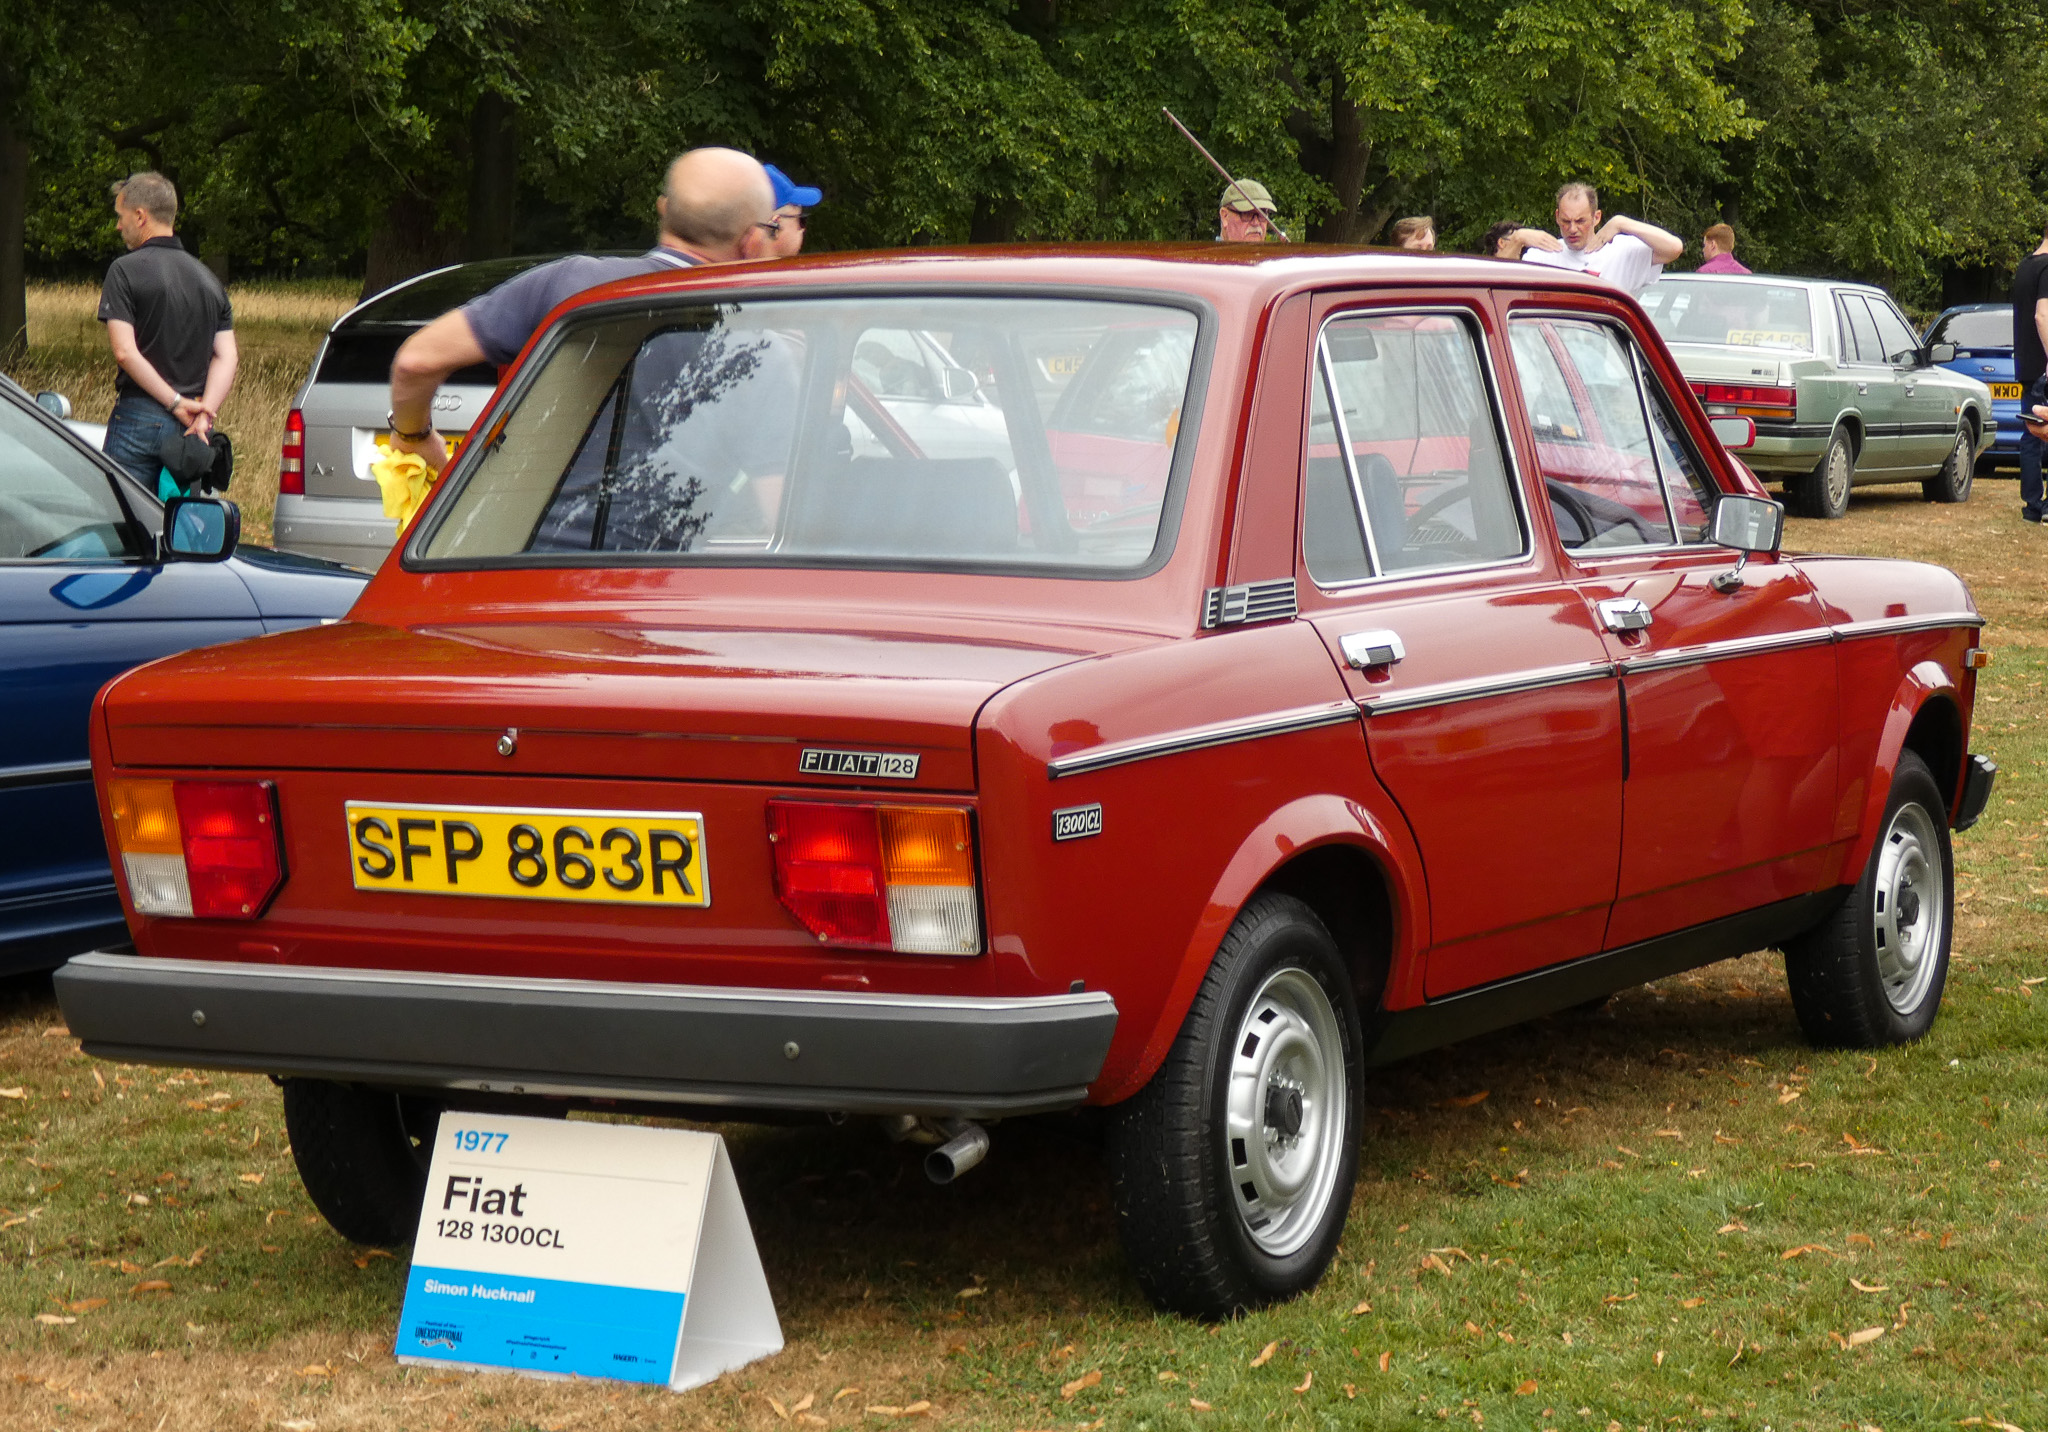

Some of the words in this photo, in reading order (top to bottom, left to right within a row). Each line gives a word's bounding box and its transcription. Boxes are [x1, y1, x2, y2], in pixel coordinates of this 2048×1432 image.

[1993, 385, 2019, 398] WWO
[804, 752, 877, 773] FIAT
[883, 758, 914, 774] 128
[355, 816, 484, 885] SFP
[507, 823, 696, 896] 863R
[454, 1129, 510, 1154] 1977
[443, 1174, 528, 1218] Fiat
[437, 1219, 475, 1240] 128
[481, 1223, 565, 1249] 1300CL
[423, 1278, 469, 1297] Simon
[471, 1283, 536, 1304] Hucknall
[414, 1326, 463, 1343] UNEXCEPTIONAL
